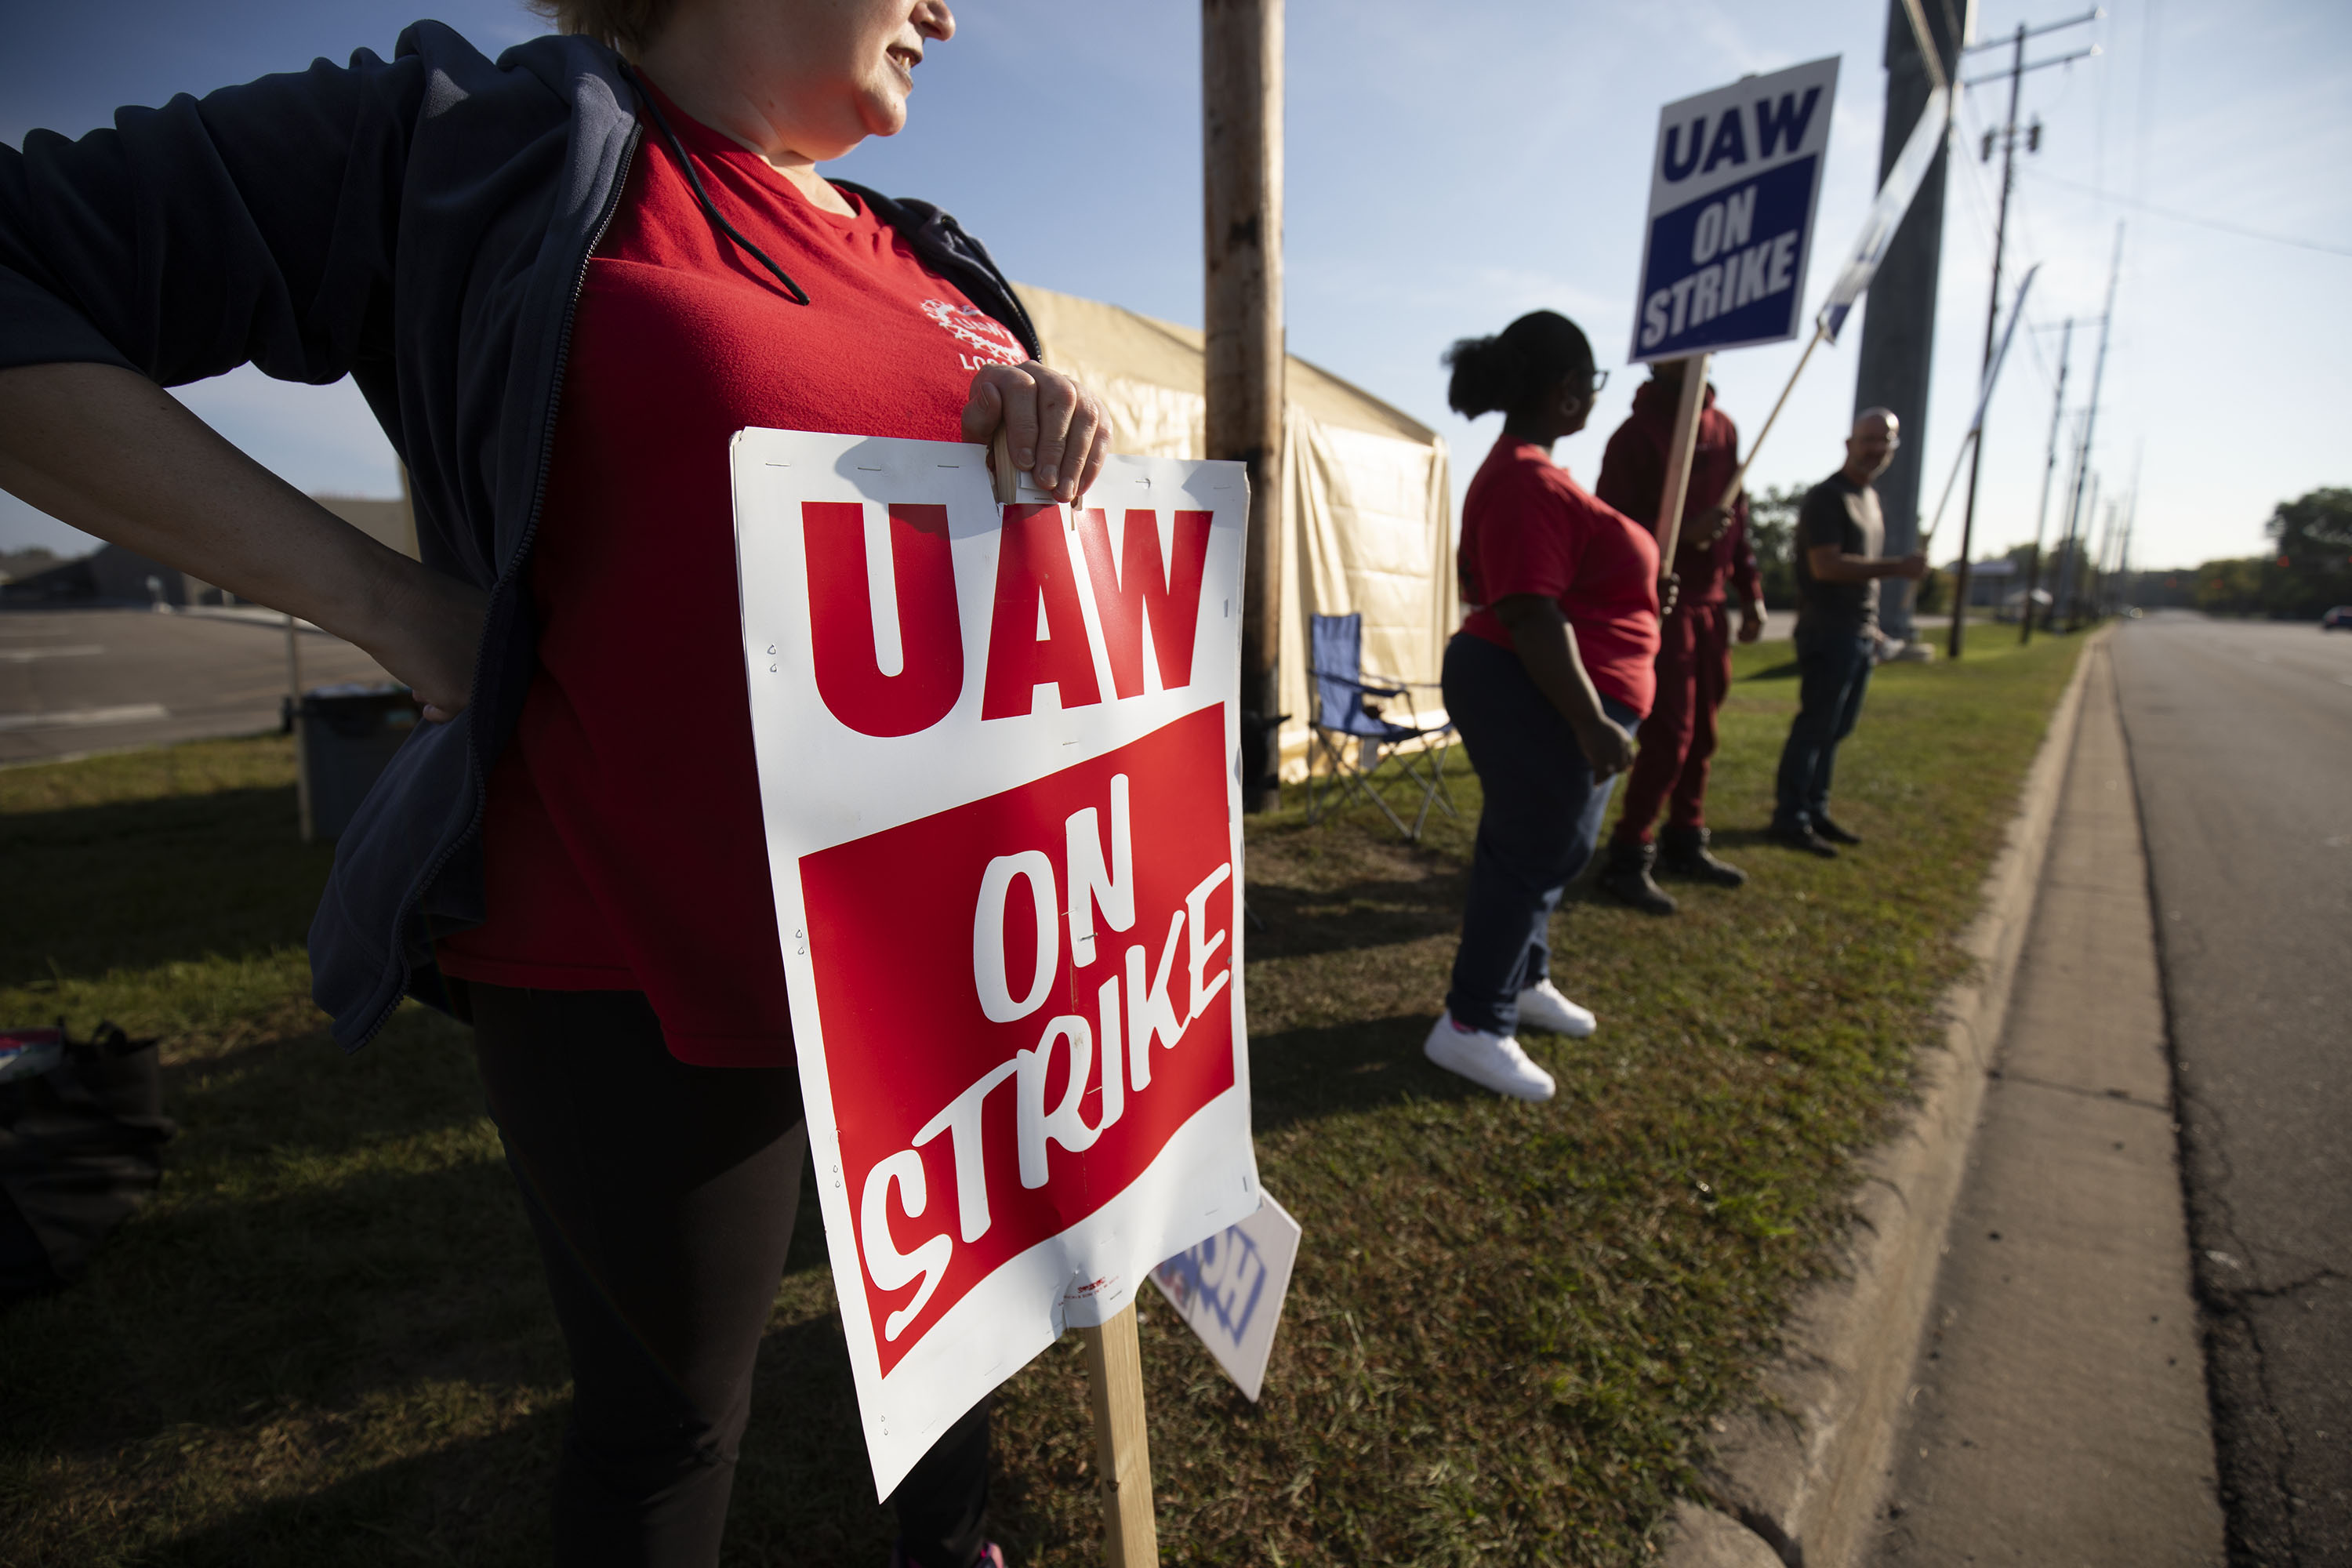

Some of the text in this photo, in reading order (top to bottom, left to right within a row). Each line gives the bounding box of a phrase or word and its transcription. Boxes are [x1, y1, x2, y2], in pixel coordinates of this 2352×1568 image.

[1662, 85, 1824, 183] UAW
[1641, 229, 1798, 350] STRIKE
[1691, 184, 1758, 266] ON
[801, 502, 1214, 738] UAW
[973, 773, 1135, 1022] ON
[860, 862, 1232, 1342] STRIKE
